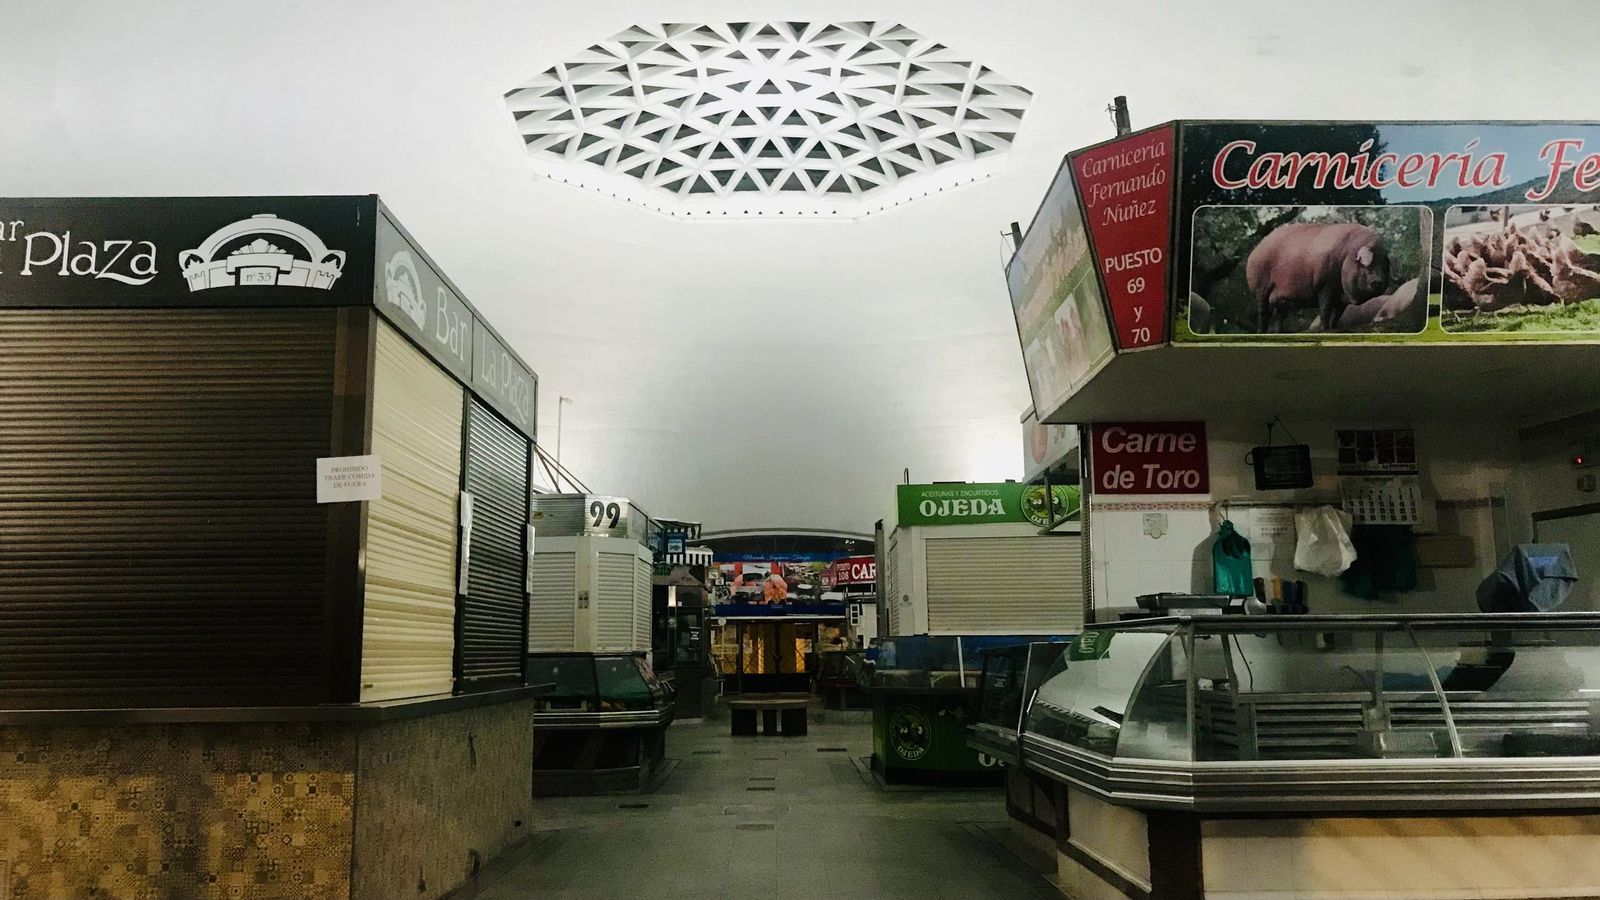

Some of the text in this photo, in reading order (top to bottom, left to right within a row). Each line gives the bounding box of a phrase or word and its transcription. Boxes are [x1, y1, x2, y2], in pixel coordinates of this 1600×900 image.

[1212, 137, 1509, 190] Carnicería
[1088, 162, 1166, 208] Fernando
[1102, 199, 1157, 226] Nuñez
[20, 231, 158, 286] Plaza
[1105, 247, 1163, 273] PUESTO
[1127, 277, 1146, 294] 69
[435, 286, 468, 362] Bar
[1134, 306, 1143, 322] y
[1131, 327, 1150, 344] 70
[481, 333, 529, 426] La Plaza
[1102, 427, 1197, 454] Carne
[348, 472, 376, 480] COMIDA
[1103, 464, 1200, 489] de Toro
[921, 490, 955, 498] ACEITUNAS
[960, 489, 999, 497] ENCURTIDOS
[590, 501, 620, 529] 99
[919, 498, 1006, 517] OJEDA
[838, 571, 849, 581] 108
